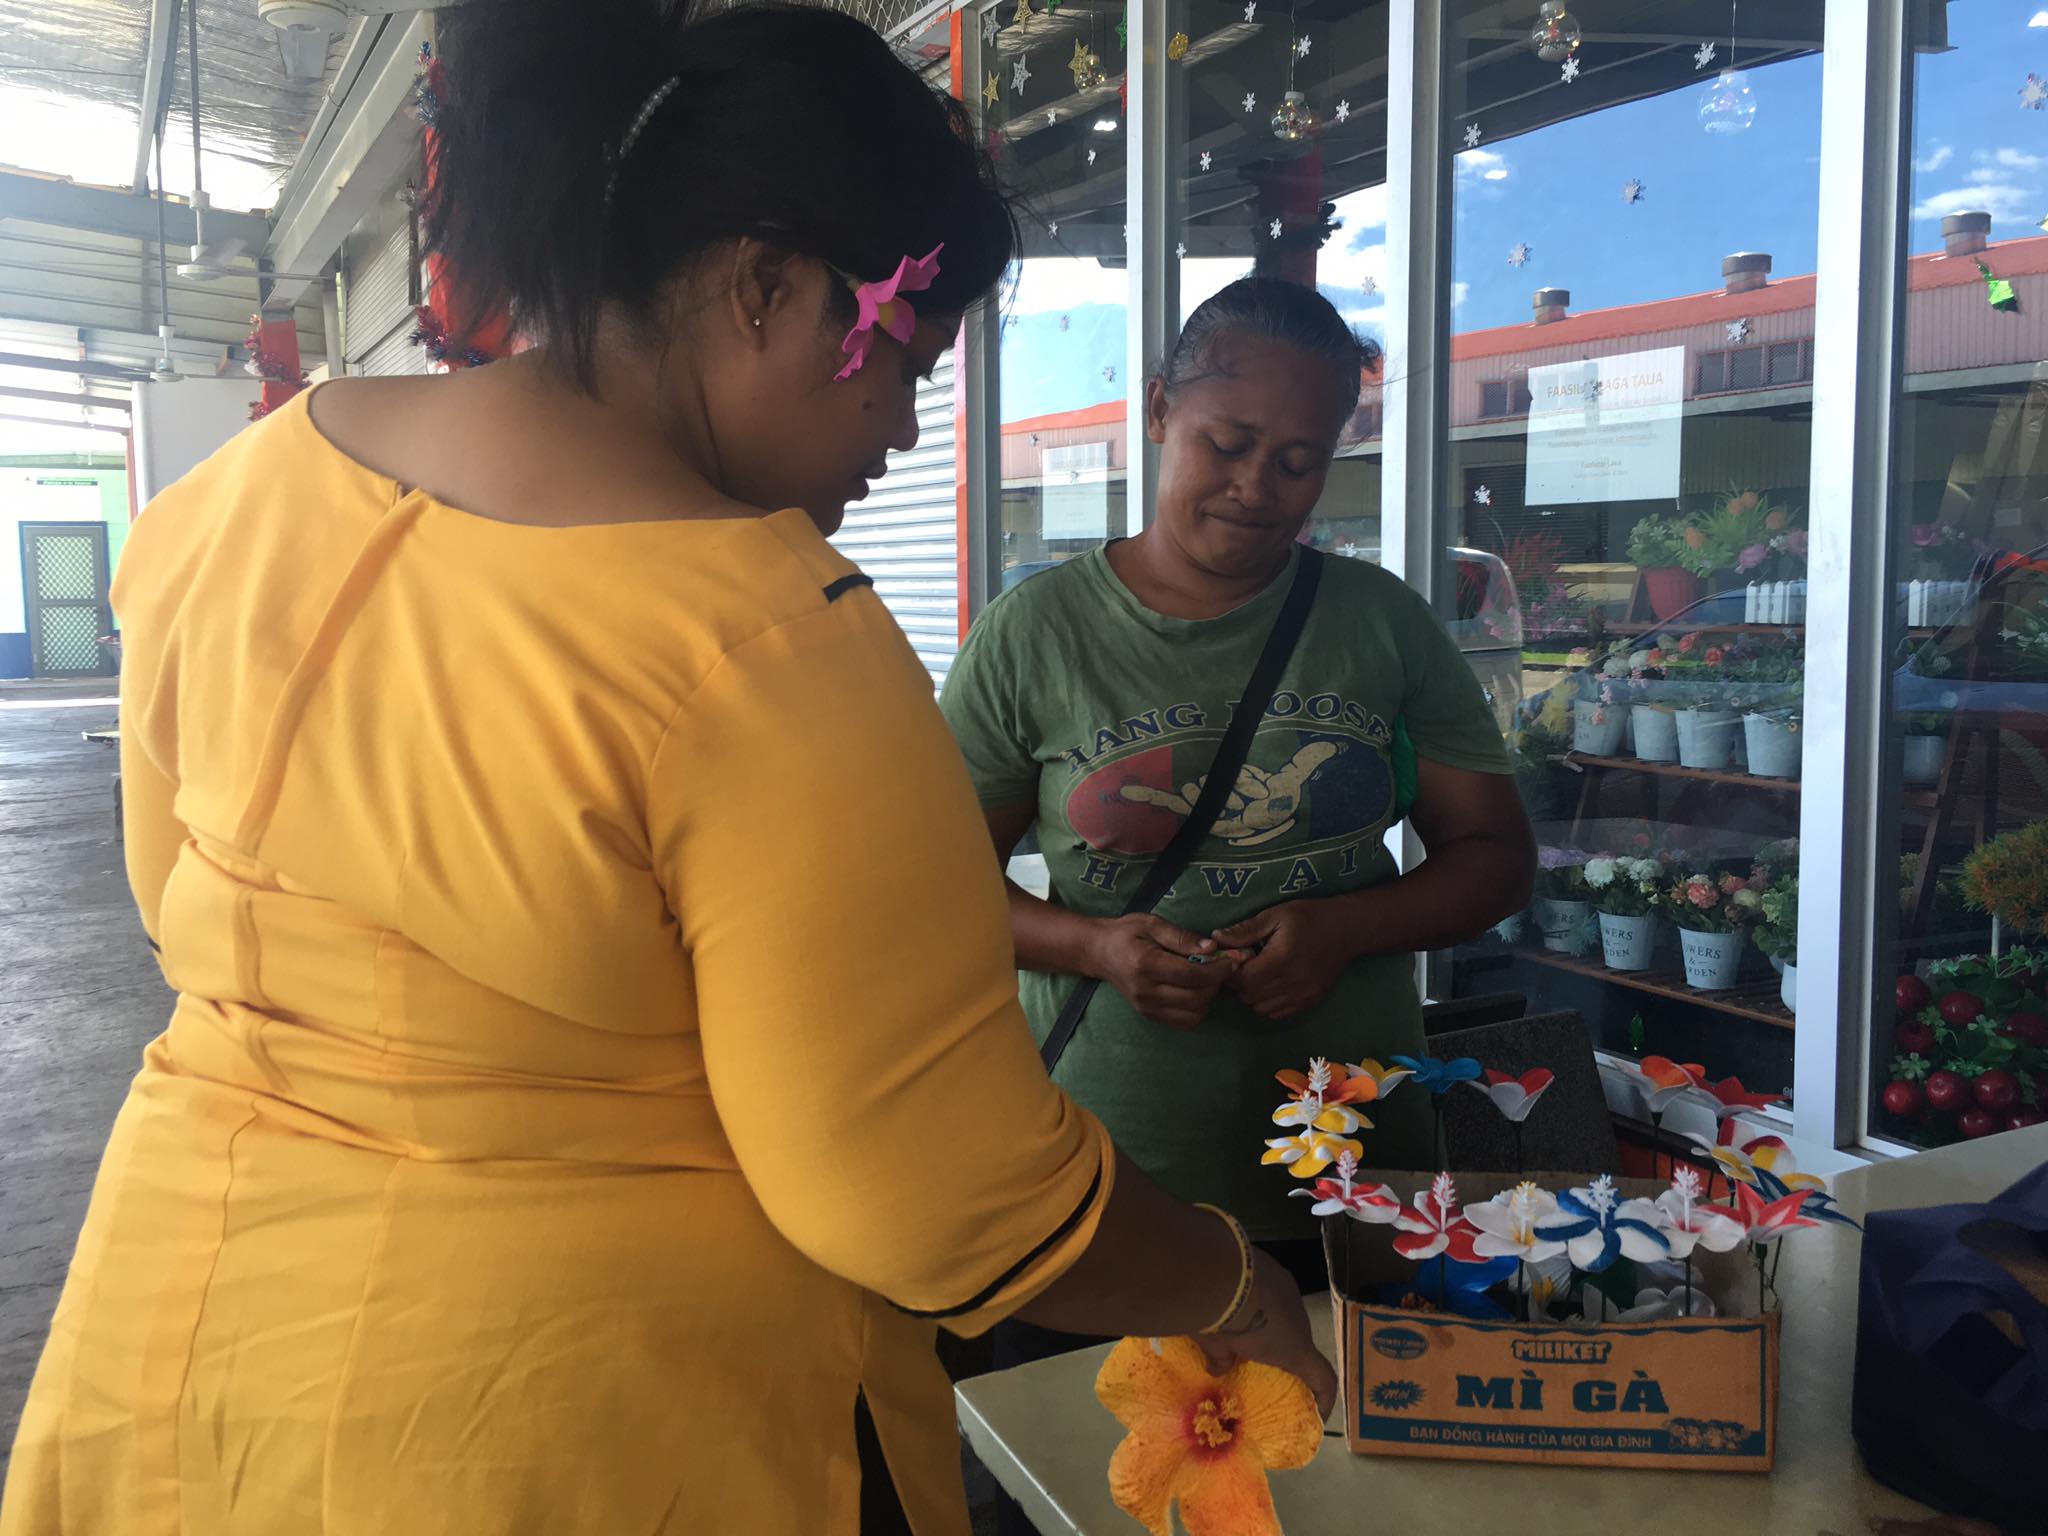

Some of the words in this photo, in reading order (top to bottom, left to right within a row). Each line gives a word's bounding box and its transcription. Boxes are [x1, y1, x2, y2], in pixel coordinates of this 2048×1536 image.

[1079, 831, 1382, 897] HWAI
[1514, 1340, 1610, 1362] MILIKET
[1456, 1369, 1543, 1411] MÌ
[1573, 1369, 1669, 1413] GÀ
[1486, 1429, 1525, 1444] HÀNH
[1590, 1433, 1613, 1447] GIA
